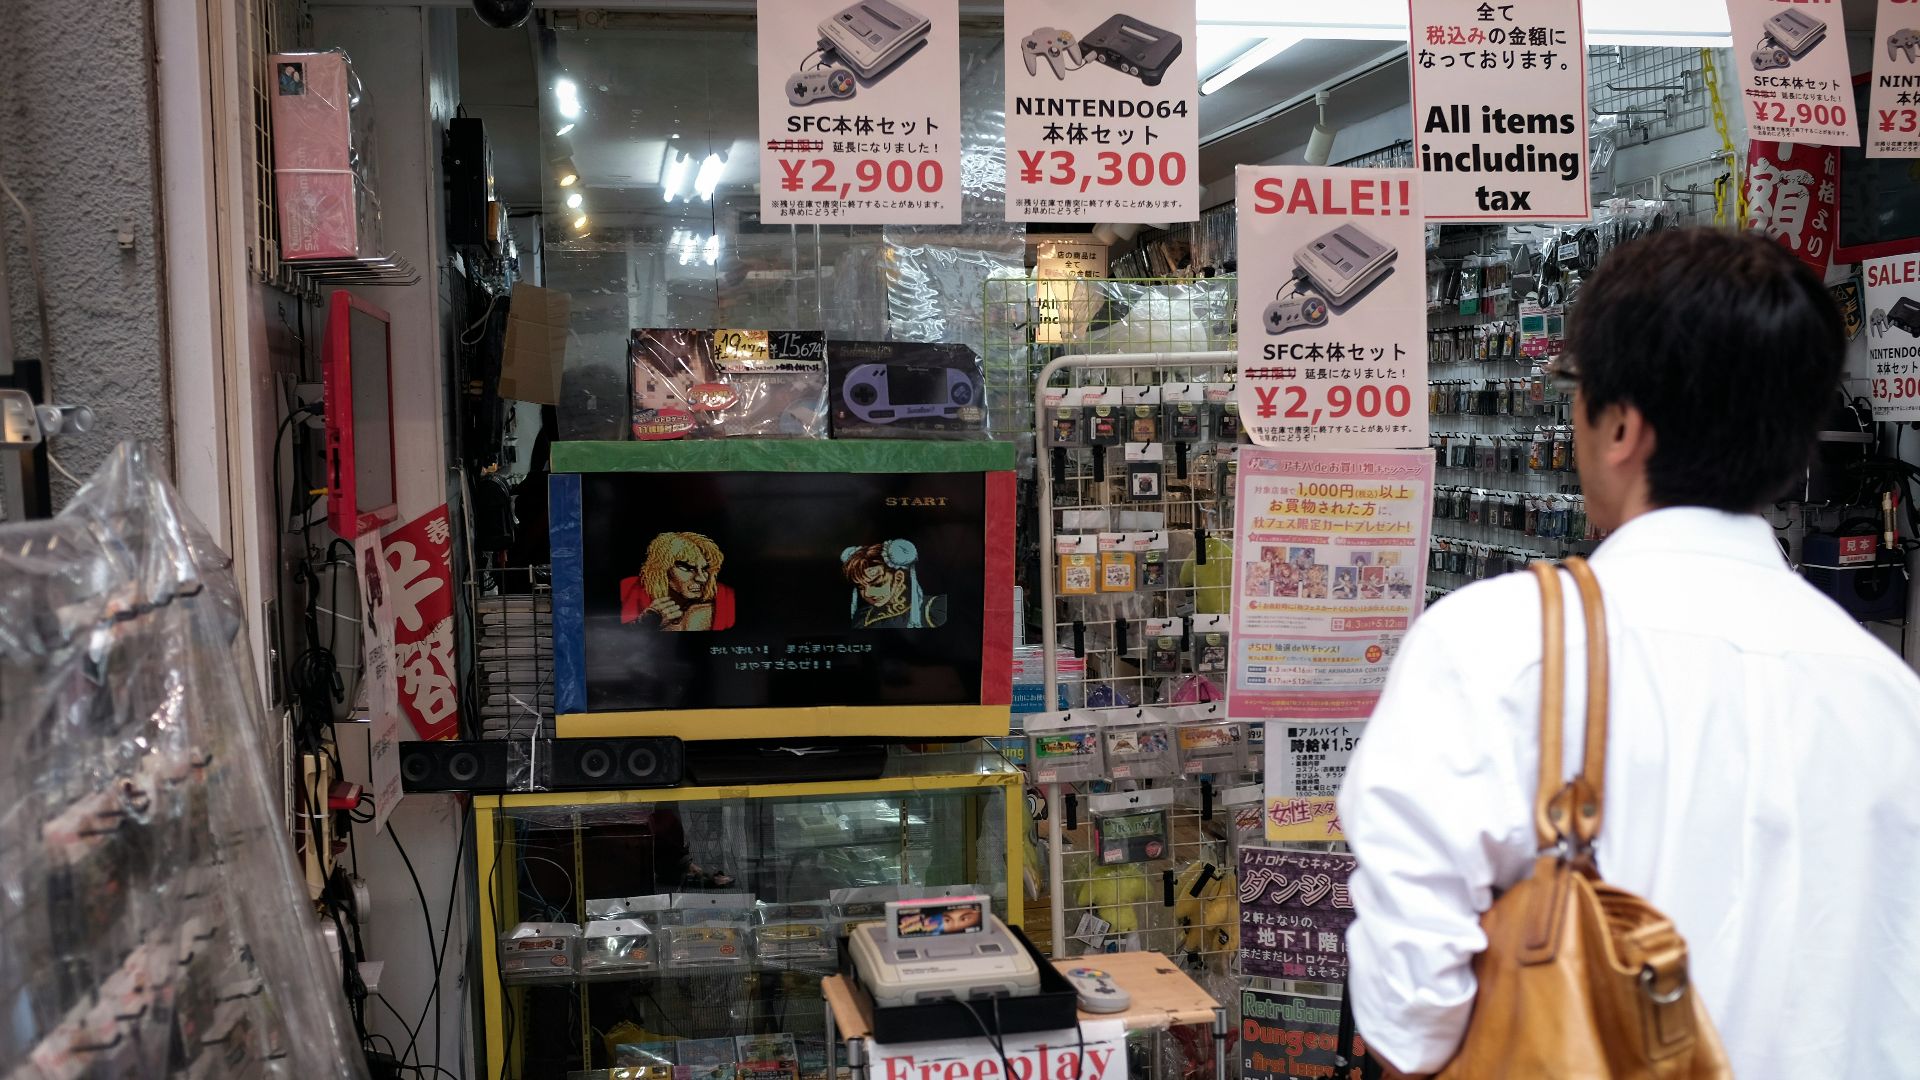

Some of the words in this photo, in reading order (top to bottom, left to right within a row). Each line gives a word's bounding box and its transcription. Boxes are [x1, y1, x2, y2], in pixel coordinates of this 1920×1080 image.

[1477, 2, 1514, 22] 全て
[1427, 25, 1566, 46] 税込みの金額に
[1419, 49, 1568, 71] なっております。
[1754, 76, 1840, 91] SFC本体セット
[1016, 98, 1188, 118] NINTENDO64
[1753, 100, 1846, 127] ¥2,900
[787, 115, 940, 136] SFC本体セット
[1425, 105, 1469, 133] All
[1483, 105, 1575, 134] items
[1043, 124, 1159, 146] 本体セット
[833, 141, 939, 154] 延長になりました！
[1018, 150, 1187, 192] ¥3,300
[1422, 144, 1580, 180] including
[778, 158, 944, 199] ¥2,900
[1254, 177, 1409, 216] SALE!!
[1475, 185, 1531, 211] tax
[1263, 342, 1406, 362] SFC本体セット
[1305, 368, 1407, 380] 延長になりました！
[1876, 357, 1919, 375] 本体セット
[1872, 378, 1920, 402] ¥3,30
[1255, 385, 1411, 425] ¥2,900
[886, 496, 948, 506] START
[1847, 539, 1870, 551] 見本
[1298, 727, 1349, 737] アルバイト
[881, 1043, 1115, 1080] Freeplay
